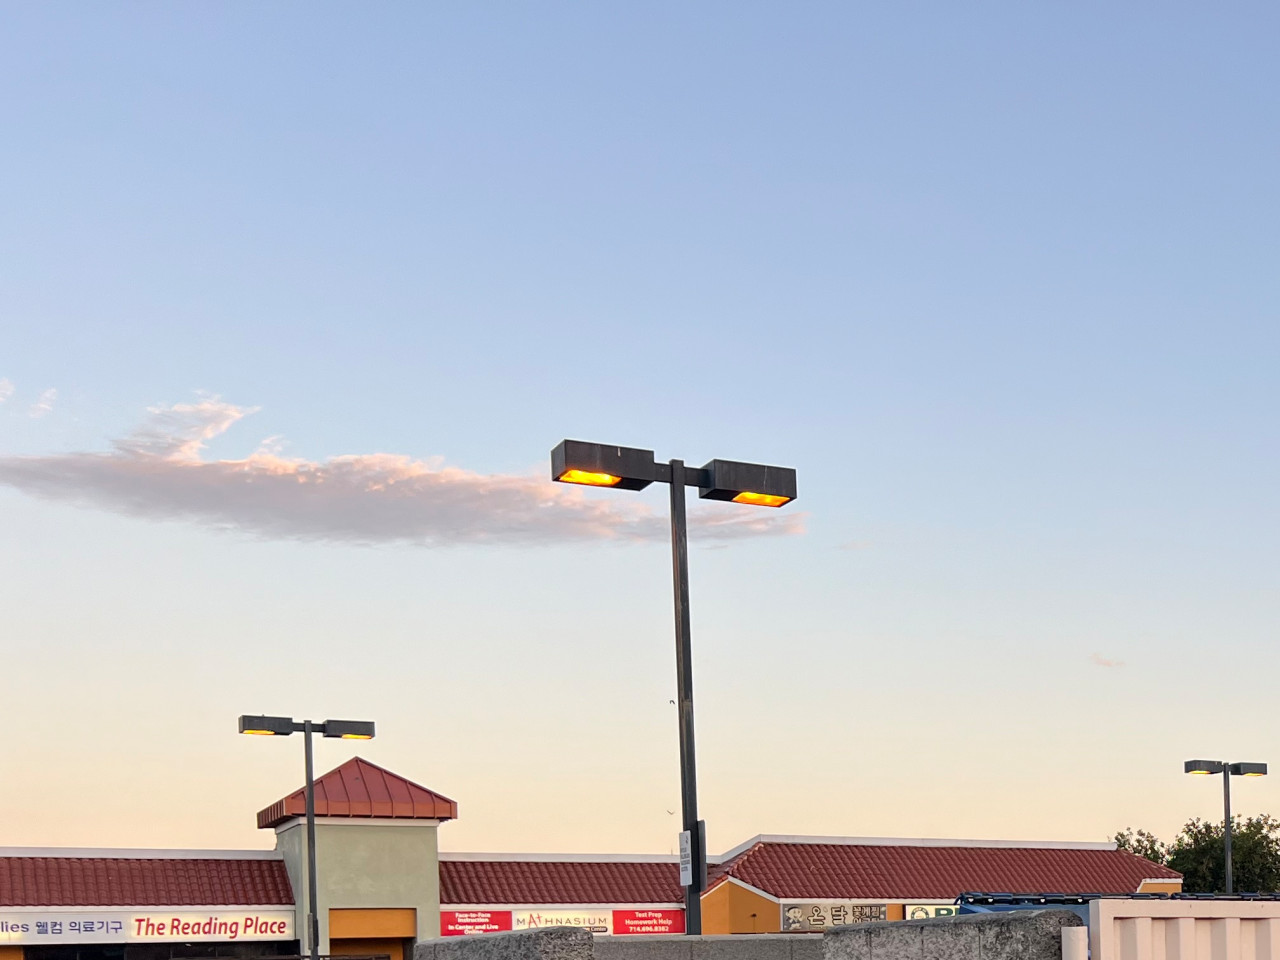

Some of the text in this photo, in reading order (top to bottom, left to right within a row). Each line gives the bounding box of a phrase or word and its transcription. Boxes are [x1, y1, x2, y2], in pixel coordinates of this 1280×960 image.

[0, 921, 30, 933] lies
[69, 921, 123, 934] 의료기구
[135, 916, 287, 939] The Reading Place
